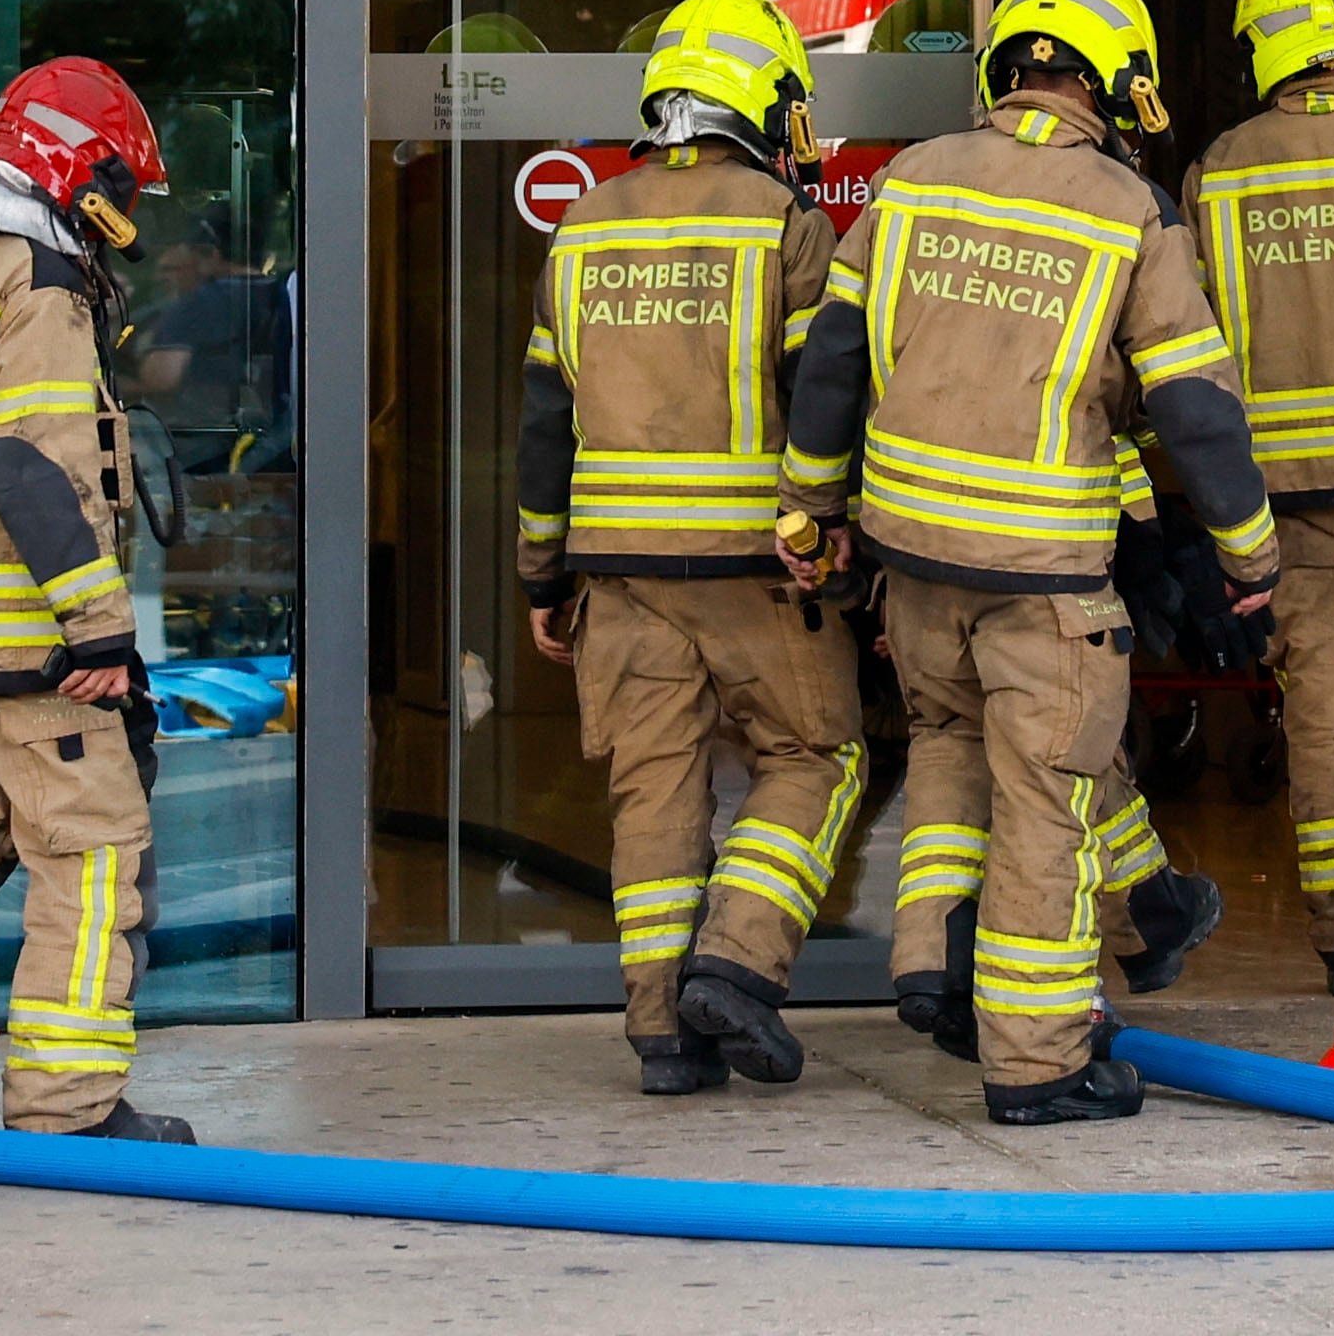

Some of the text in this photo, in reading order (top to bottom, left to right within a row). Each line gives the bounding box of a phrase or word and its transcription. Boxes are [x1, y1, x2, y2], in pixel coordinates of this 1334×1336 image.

[582, 261, 729, 291] BOMBERS
[916, 231, 1077, 285] BOMBERS
[579, 293, 730, 326] VALÈNCIA
[906, 267, 1067, 325] VALÈNCIA
